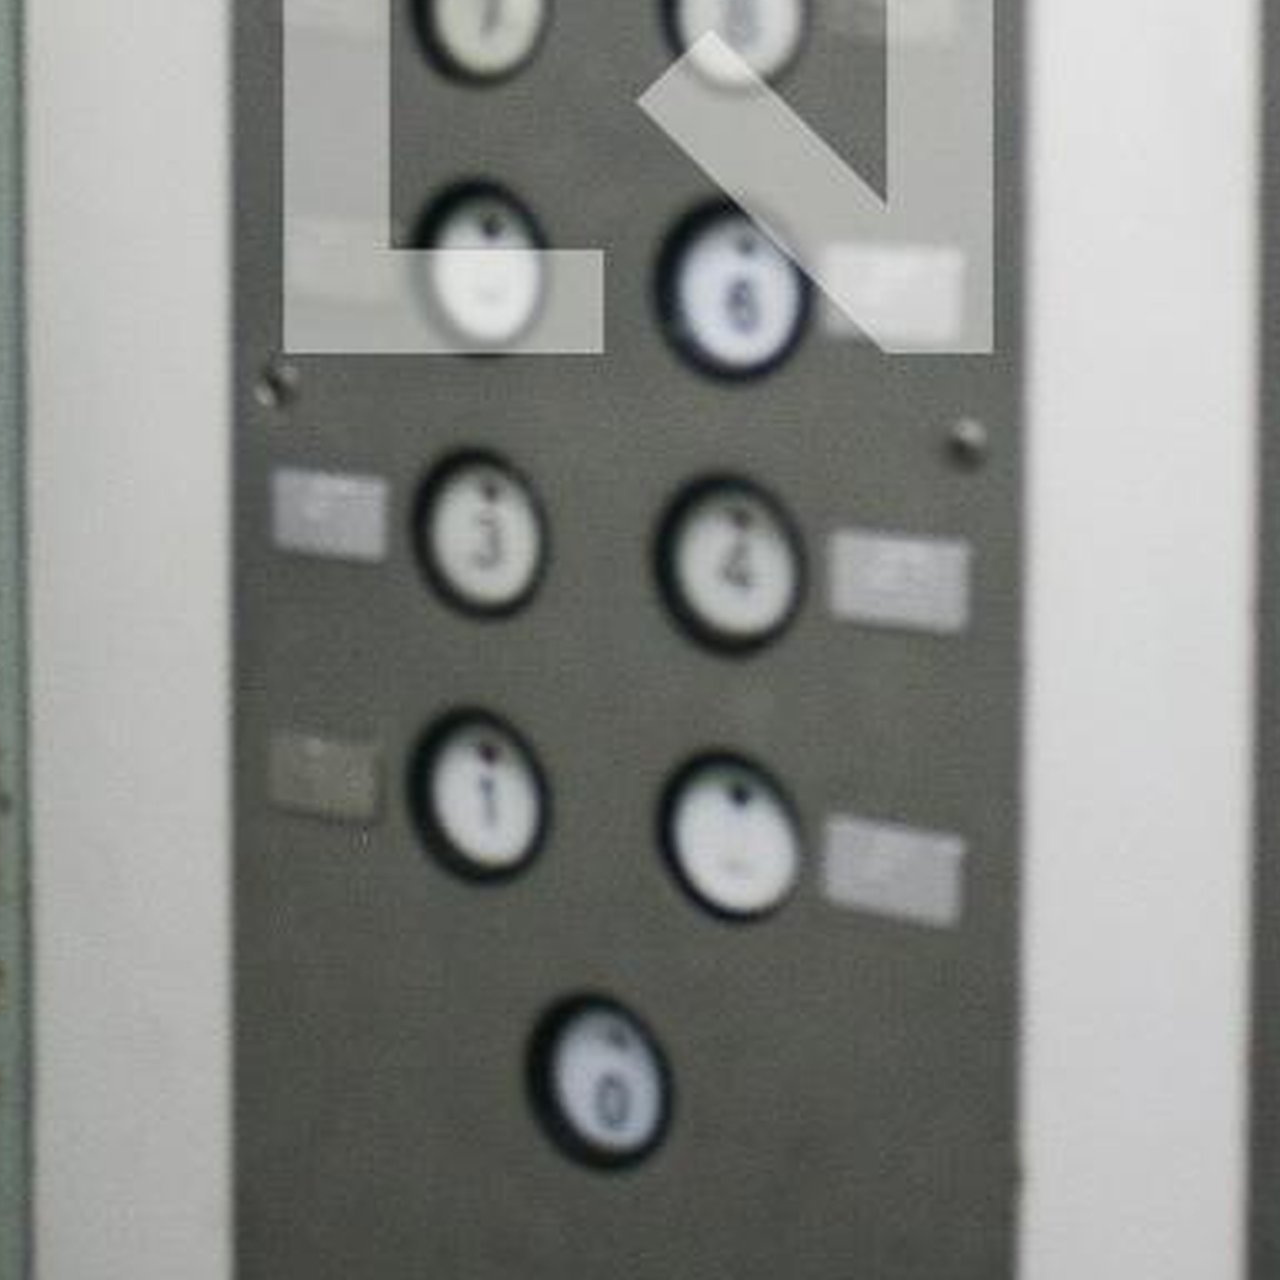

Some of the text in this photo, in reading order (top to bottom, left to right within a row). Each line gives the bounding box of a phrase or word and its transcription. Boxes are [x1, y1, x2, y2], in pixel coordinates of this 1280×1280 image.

[472, 512, 503, 572] 3
[720, 538, 756, 592] 4
[593, 1071, 631, 1132] 0
